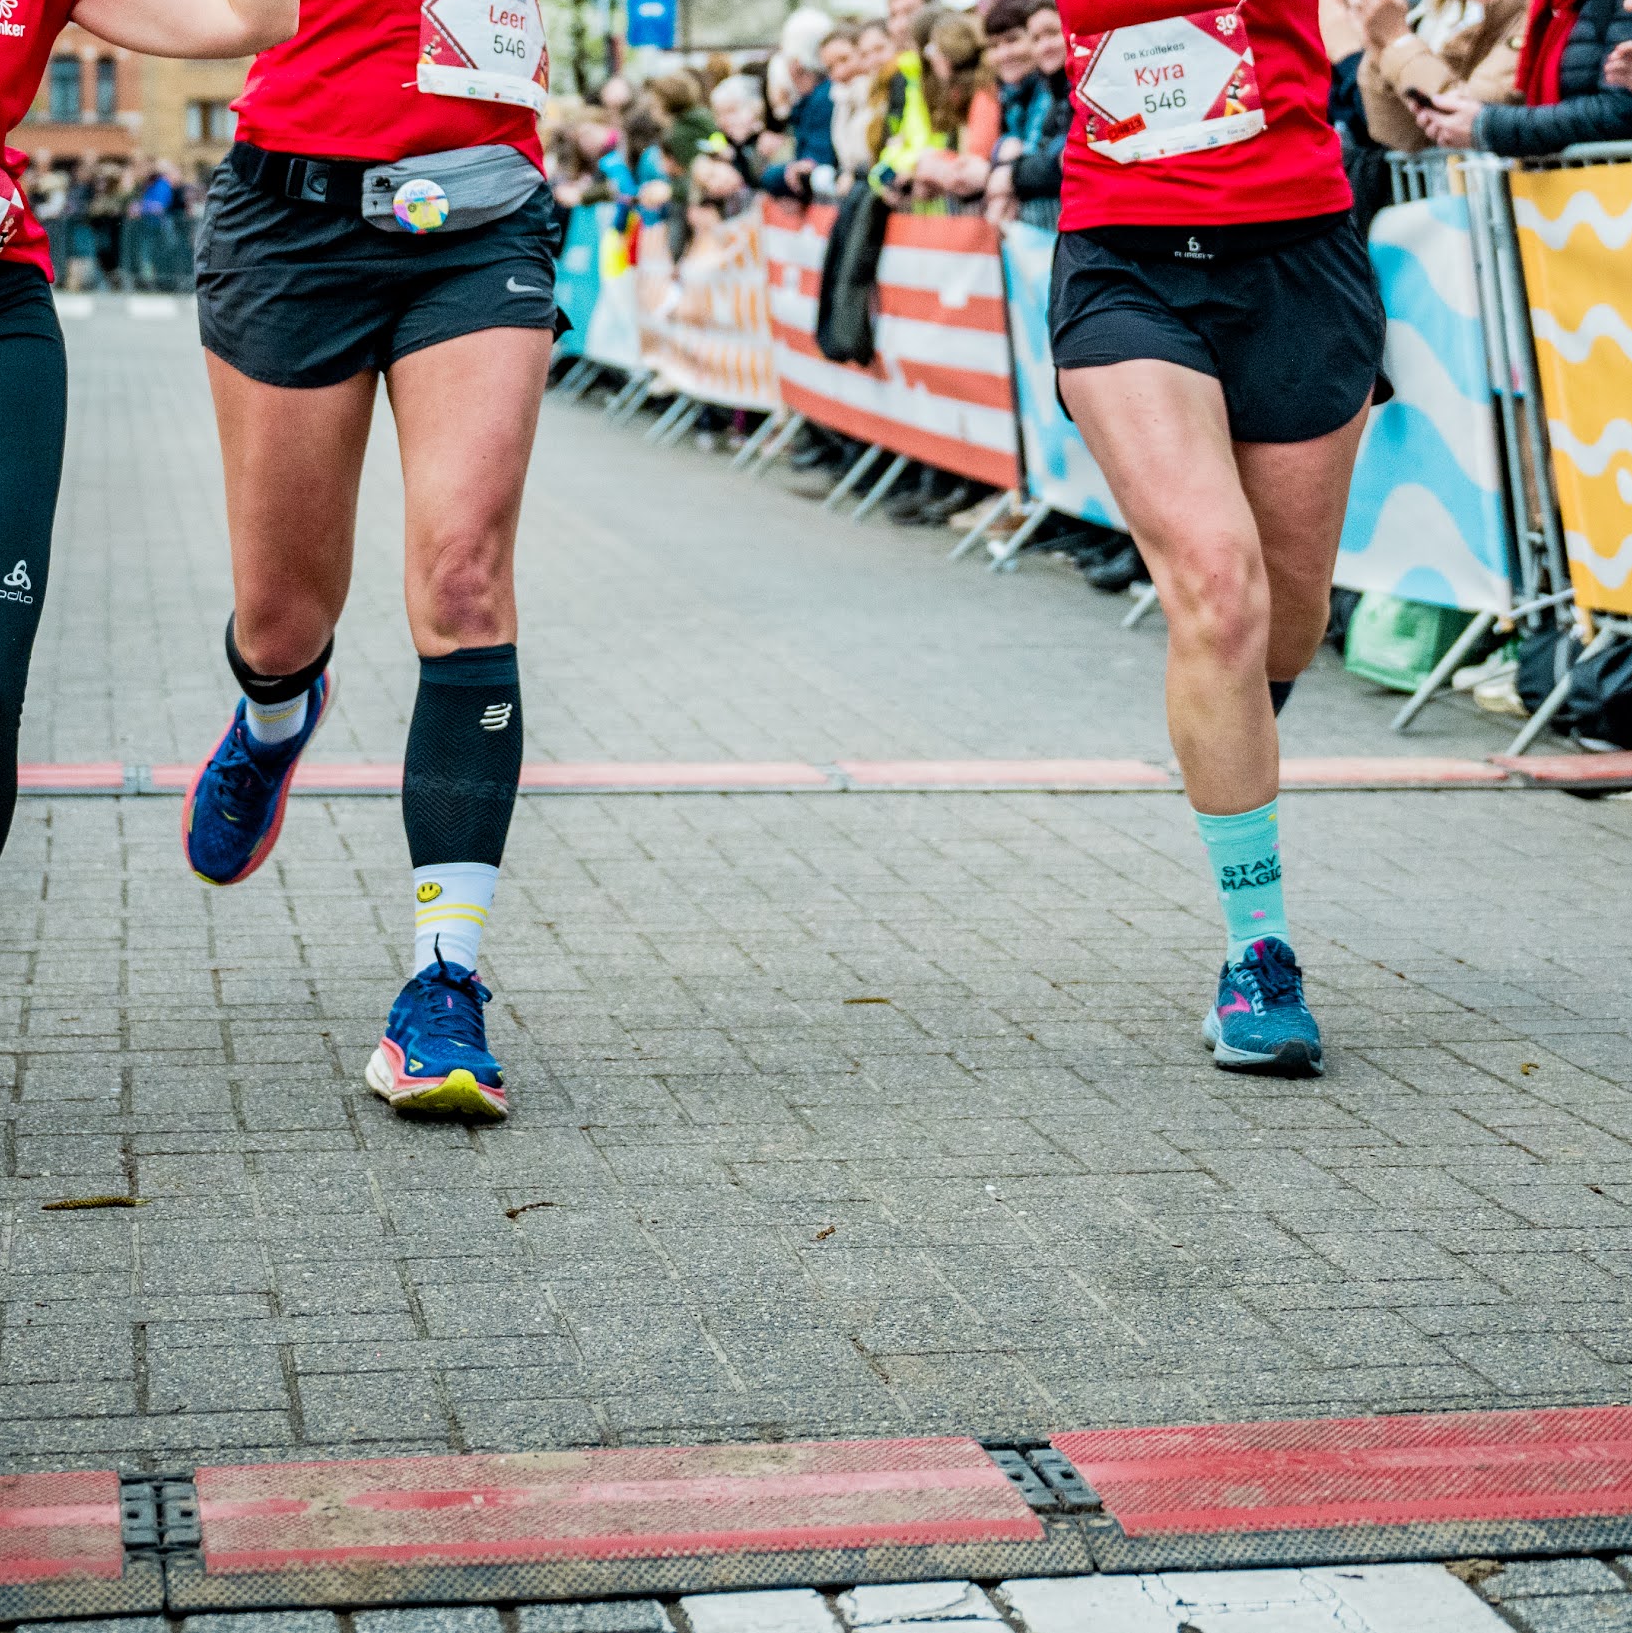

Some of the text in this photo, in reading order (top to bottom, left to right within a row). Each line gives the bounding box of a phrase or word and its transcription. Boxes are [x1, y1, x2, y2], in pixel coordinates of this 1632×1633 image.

[1215, 13, 1238, 32] 30
[493, 34, 526, 59] 546
[1123, 41, 1186, 62] De Krollekes
[1134, 63, 1185, 87] Kyra
[1143, 88, 1187, 114] 546
[1222, 854, 1276, 878] STAY
